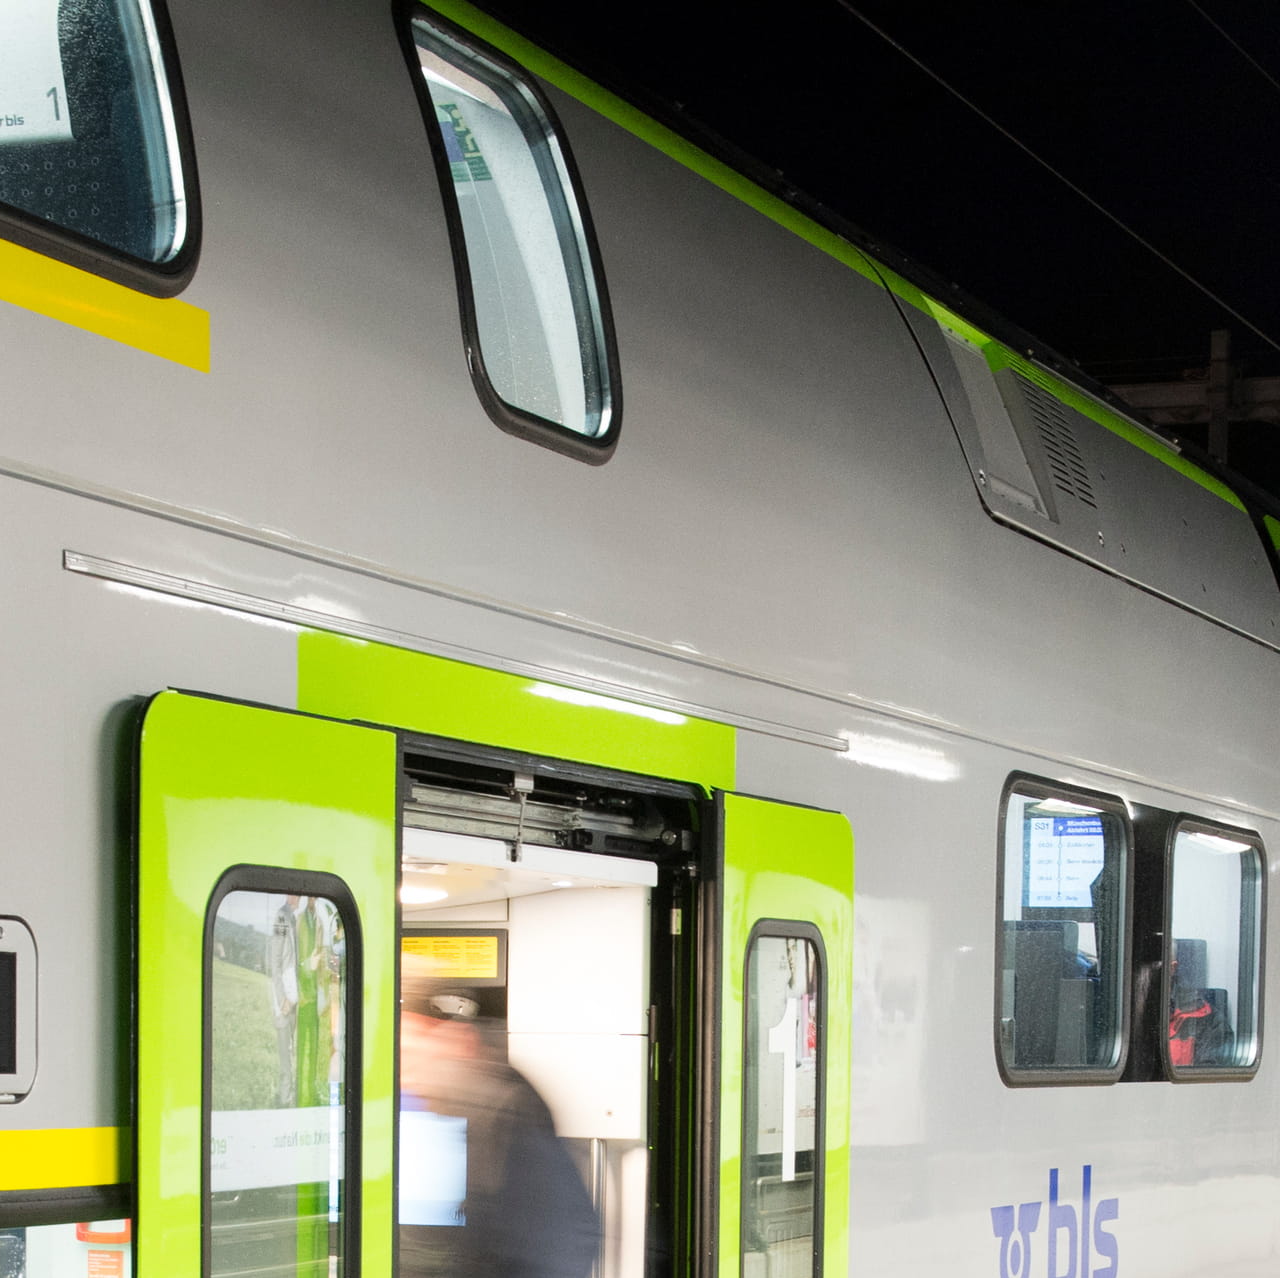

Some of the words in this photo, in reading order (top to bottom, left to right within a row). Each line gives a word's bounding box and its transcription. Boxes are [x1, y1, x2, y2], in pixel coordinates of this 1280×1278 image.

[5, 113, 25, 127] bls
[46, 86, 60, 121] 1
[768, 997, 797, 1182] 1
